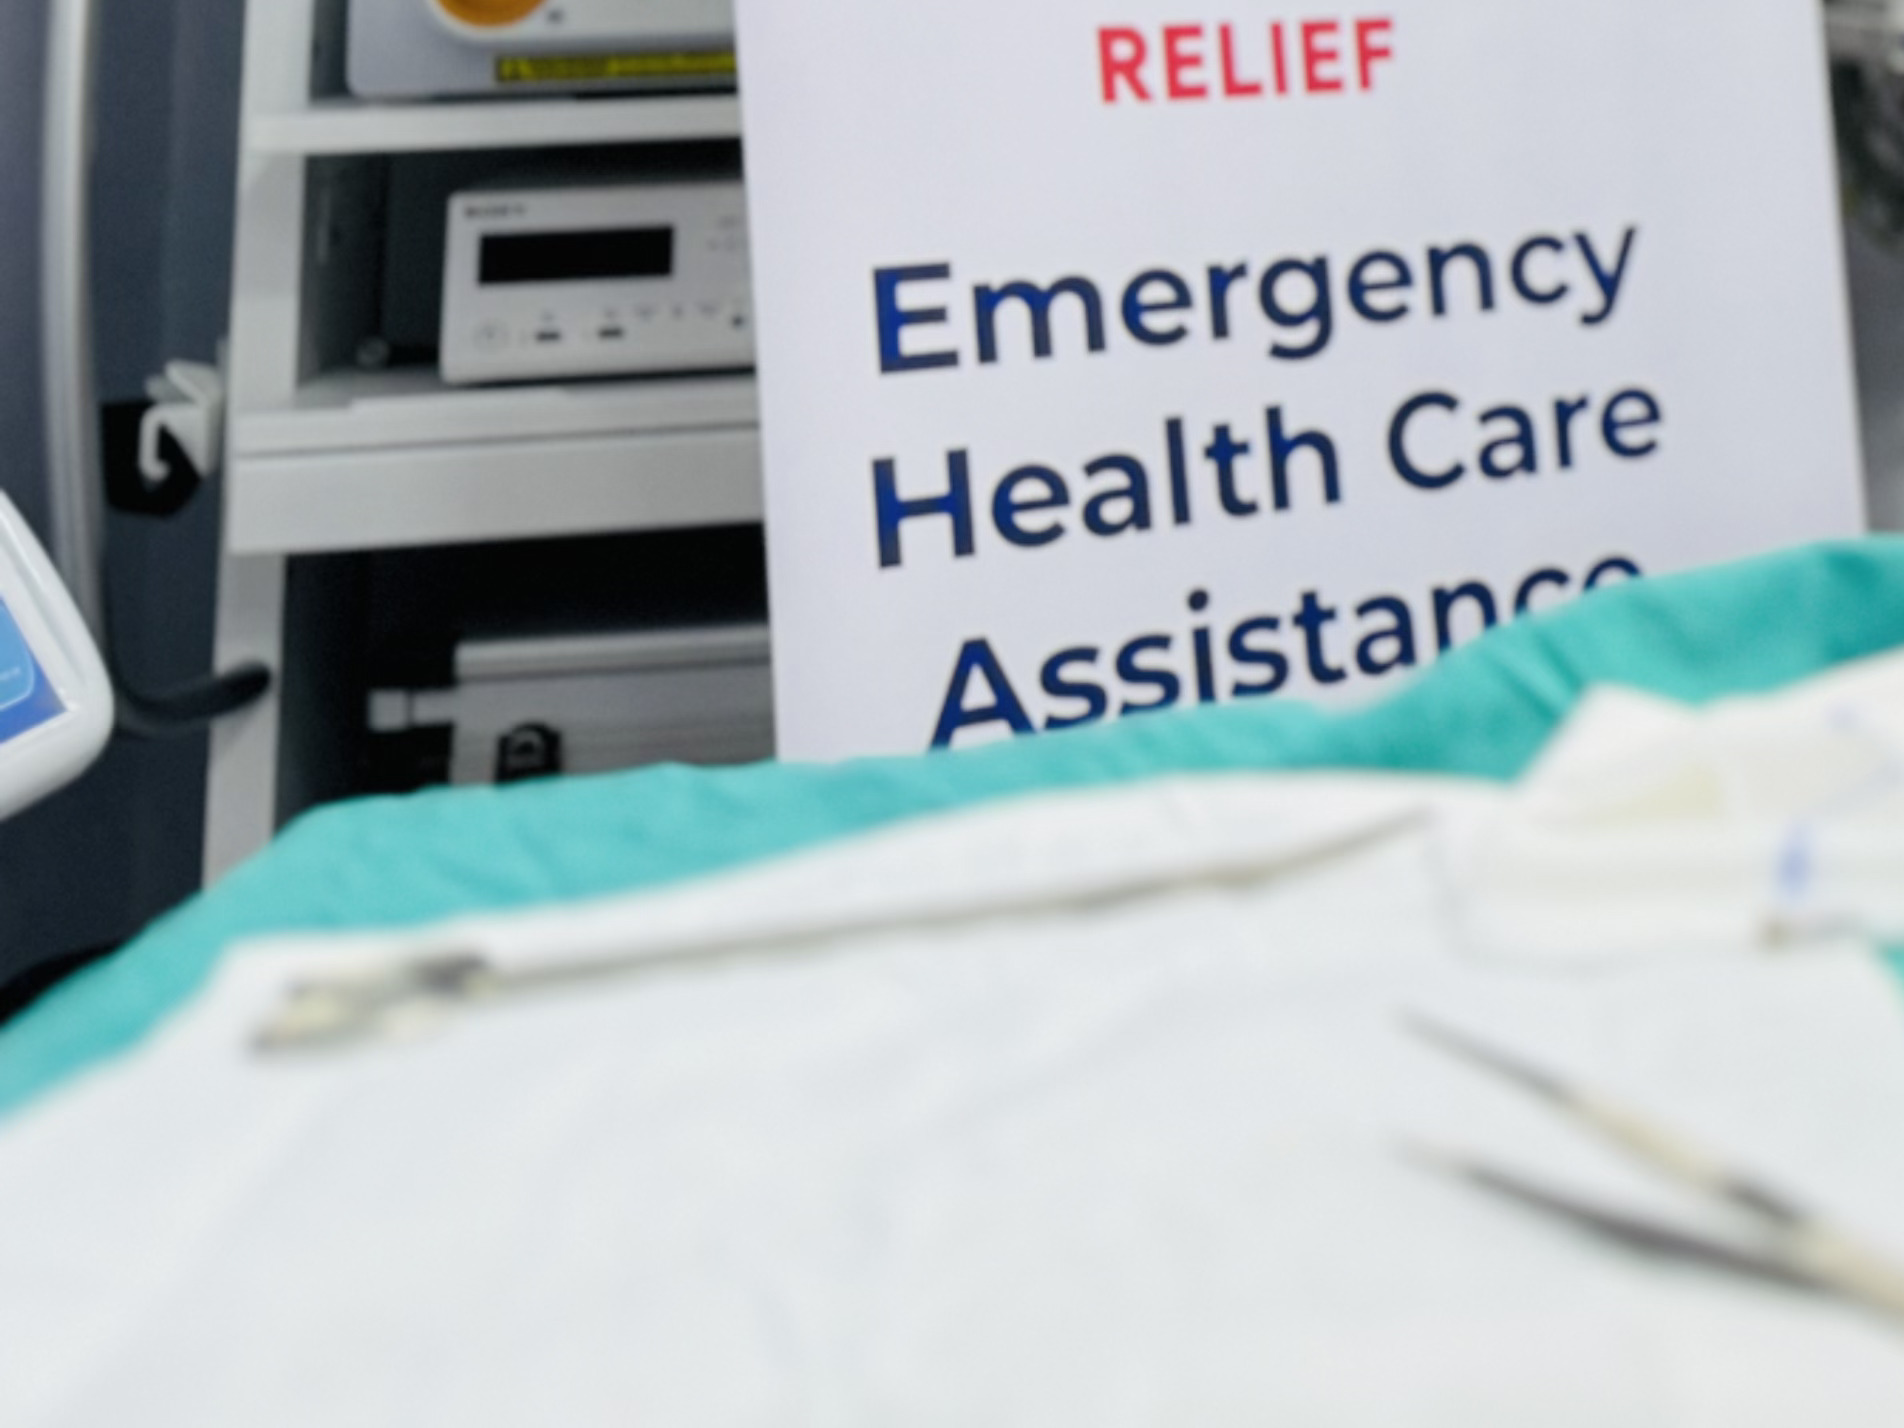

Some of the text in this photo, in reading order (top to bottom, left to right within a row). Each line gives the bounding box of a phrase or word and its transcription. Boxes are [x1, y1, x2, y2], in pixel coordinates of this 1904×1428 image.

[1096, 16, 1394, 106] RELIEF
[872, 226, 1638, 375] Emergency
[871, 386, 1662, 570] Health Care
